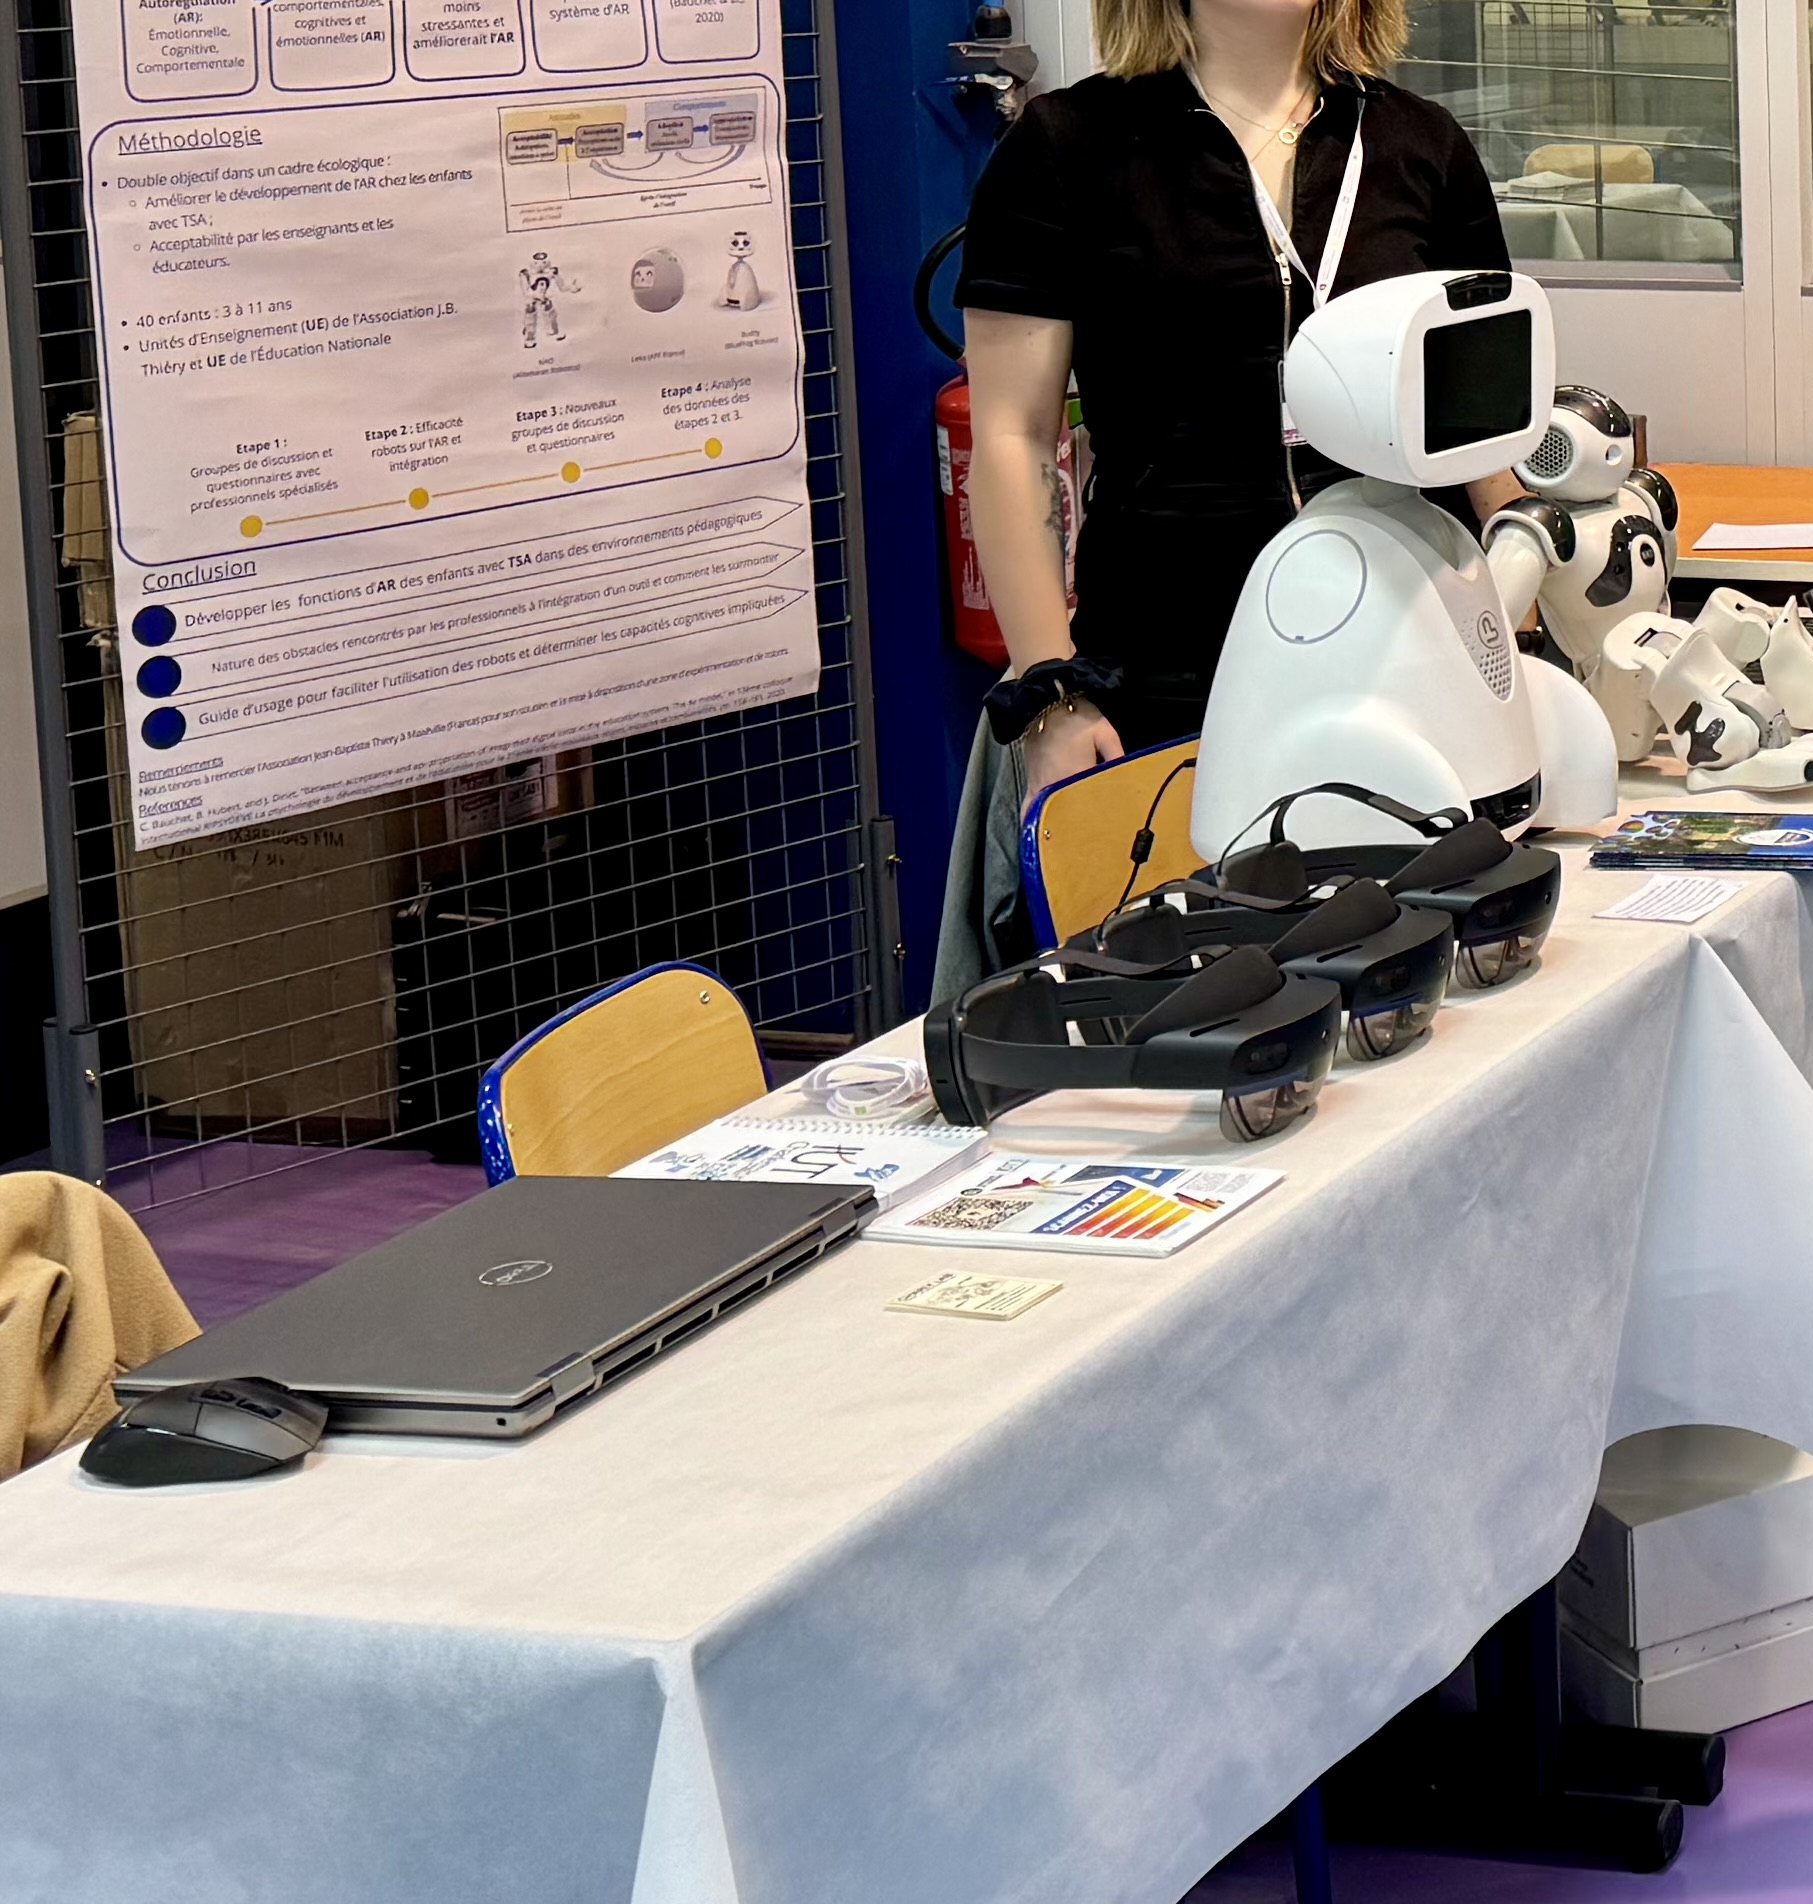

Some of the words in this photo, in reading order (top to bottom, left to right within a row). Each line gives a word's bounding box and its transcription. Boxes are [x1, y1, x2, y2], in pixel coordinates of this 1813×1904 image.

[118, 126, 262, 155] Méthodologie
[139, 336, 184, 352] Unités
[301, 316, 329, 333] (UE)
[332, 314, 349, 329] de
[236, 440, 270, 455] Etape
[142, 559, 256, 593] Conclusion
